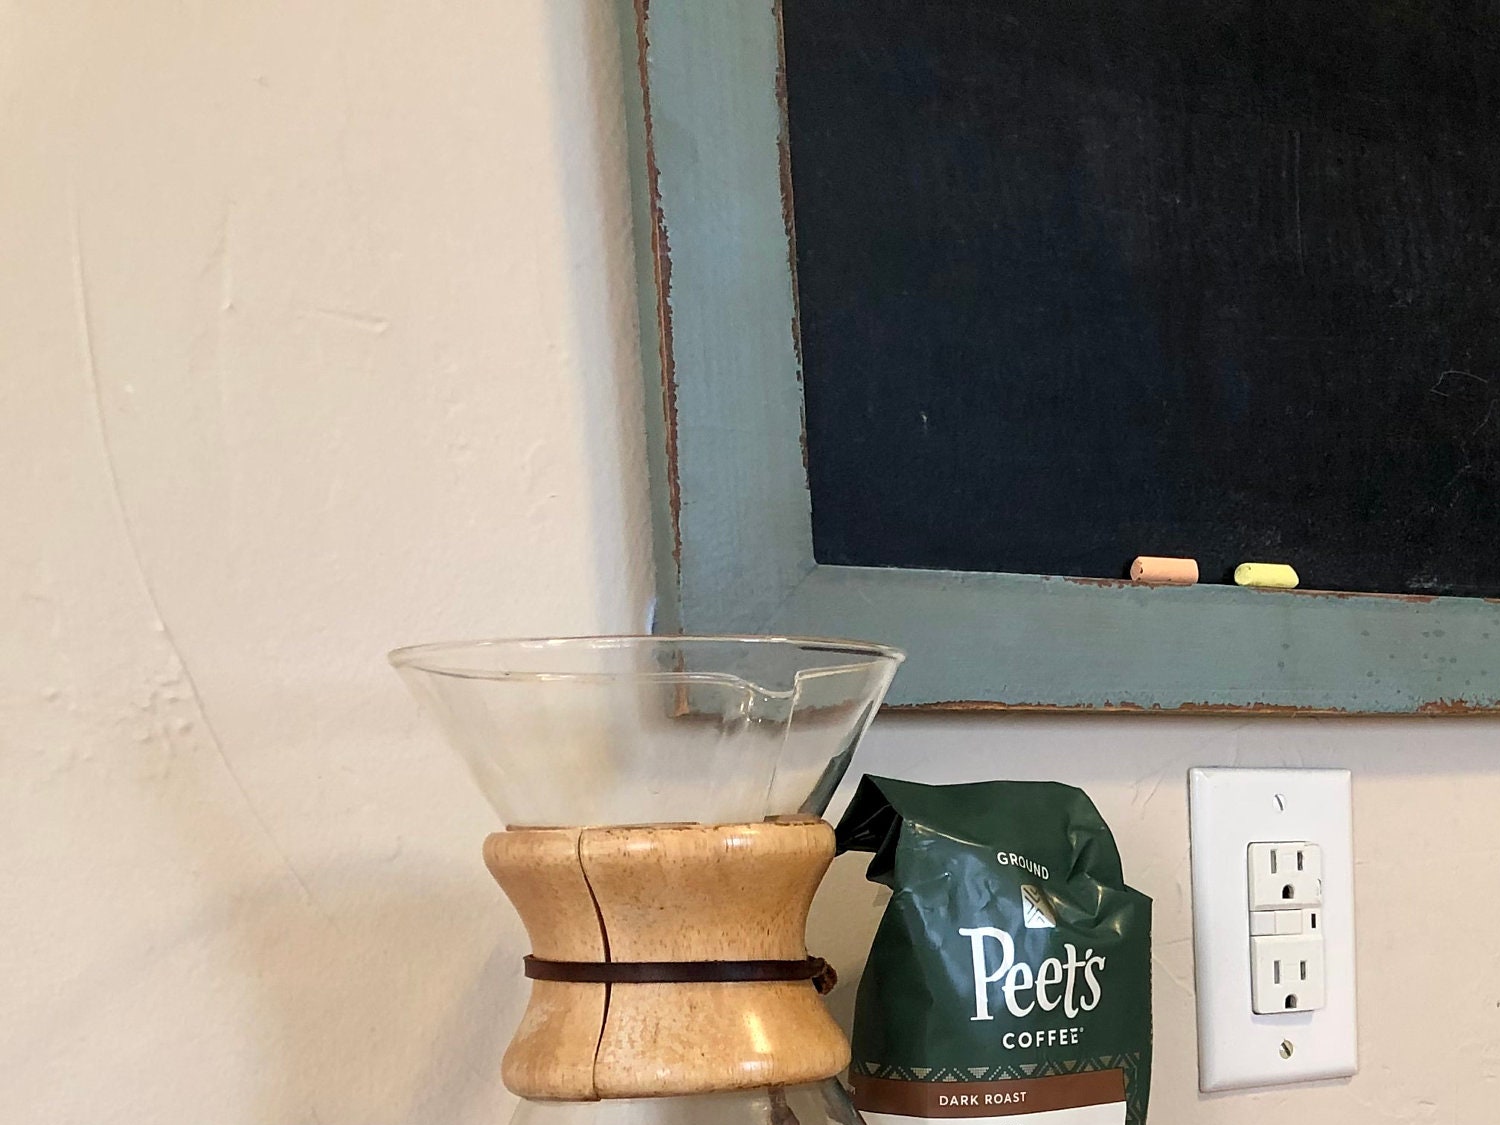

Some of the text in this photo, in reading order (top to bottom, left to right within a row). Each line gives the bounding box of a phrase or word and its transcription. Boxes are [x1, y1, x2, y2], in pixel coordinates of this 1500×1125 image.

[997, 851, 1049, 880] GROUND
[958, 926, 1105, 1021] Peet's
[1002, 1027, 1079, 1050] COFFEE
[939, 1091, 1027, 1106] DARK ROAST
